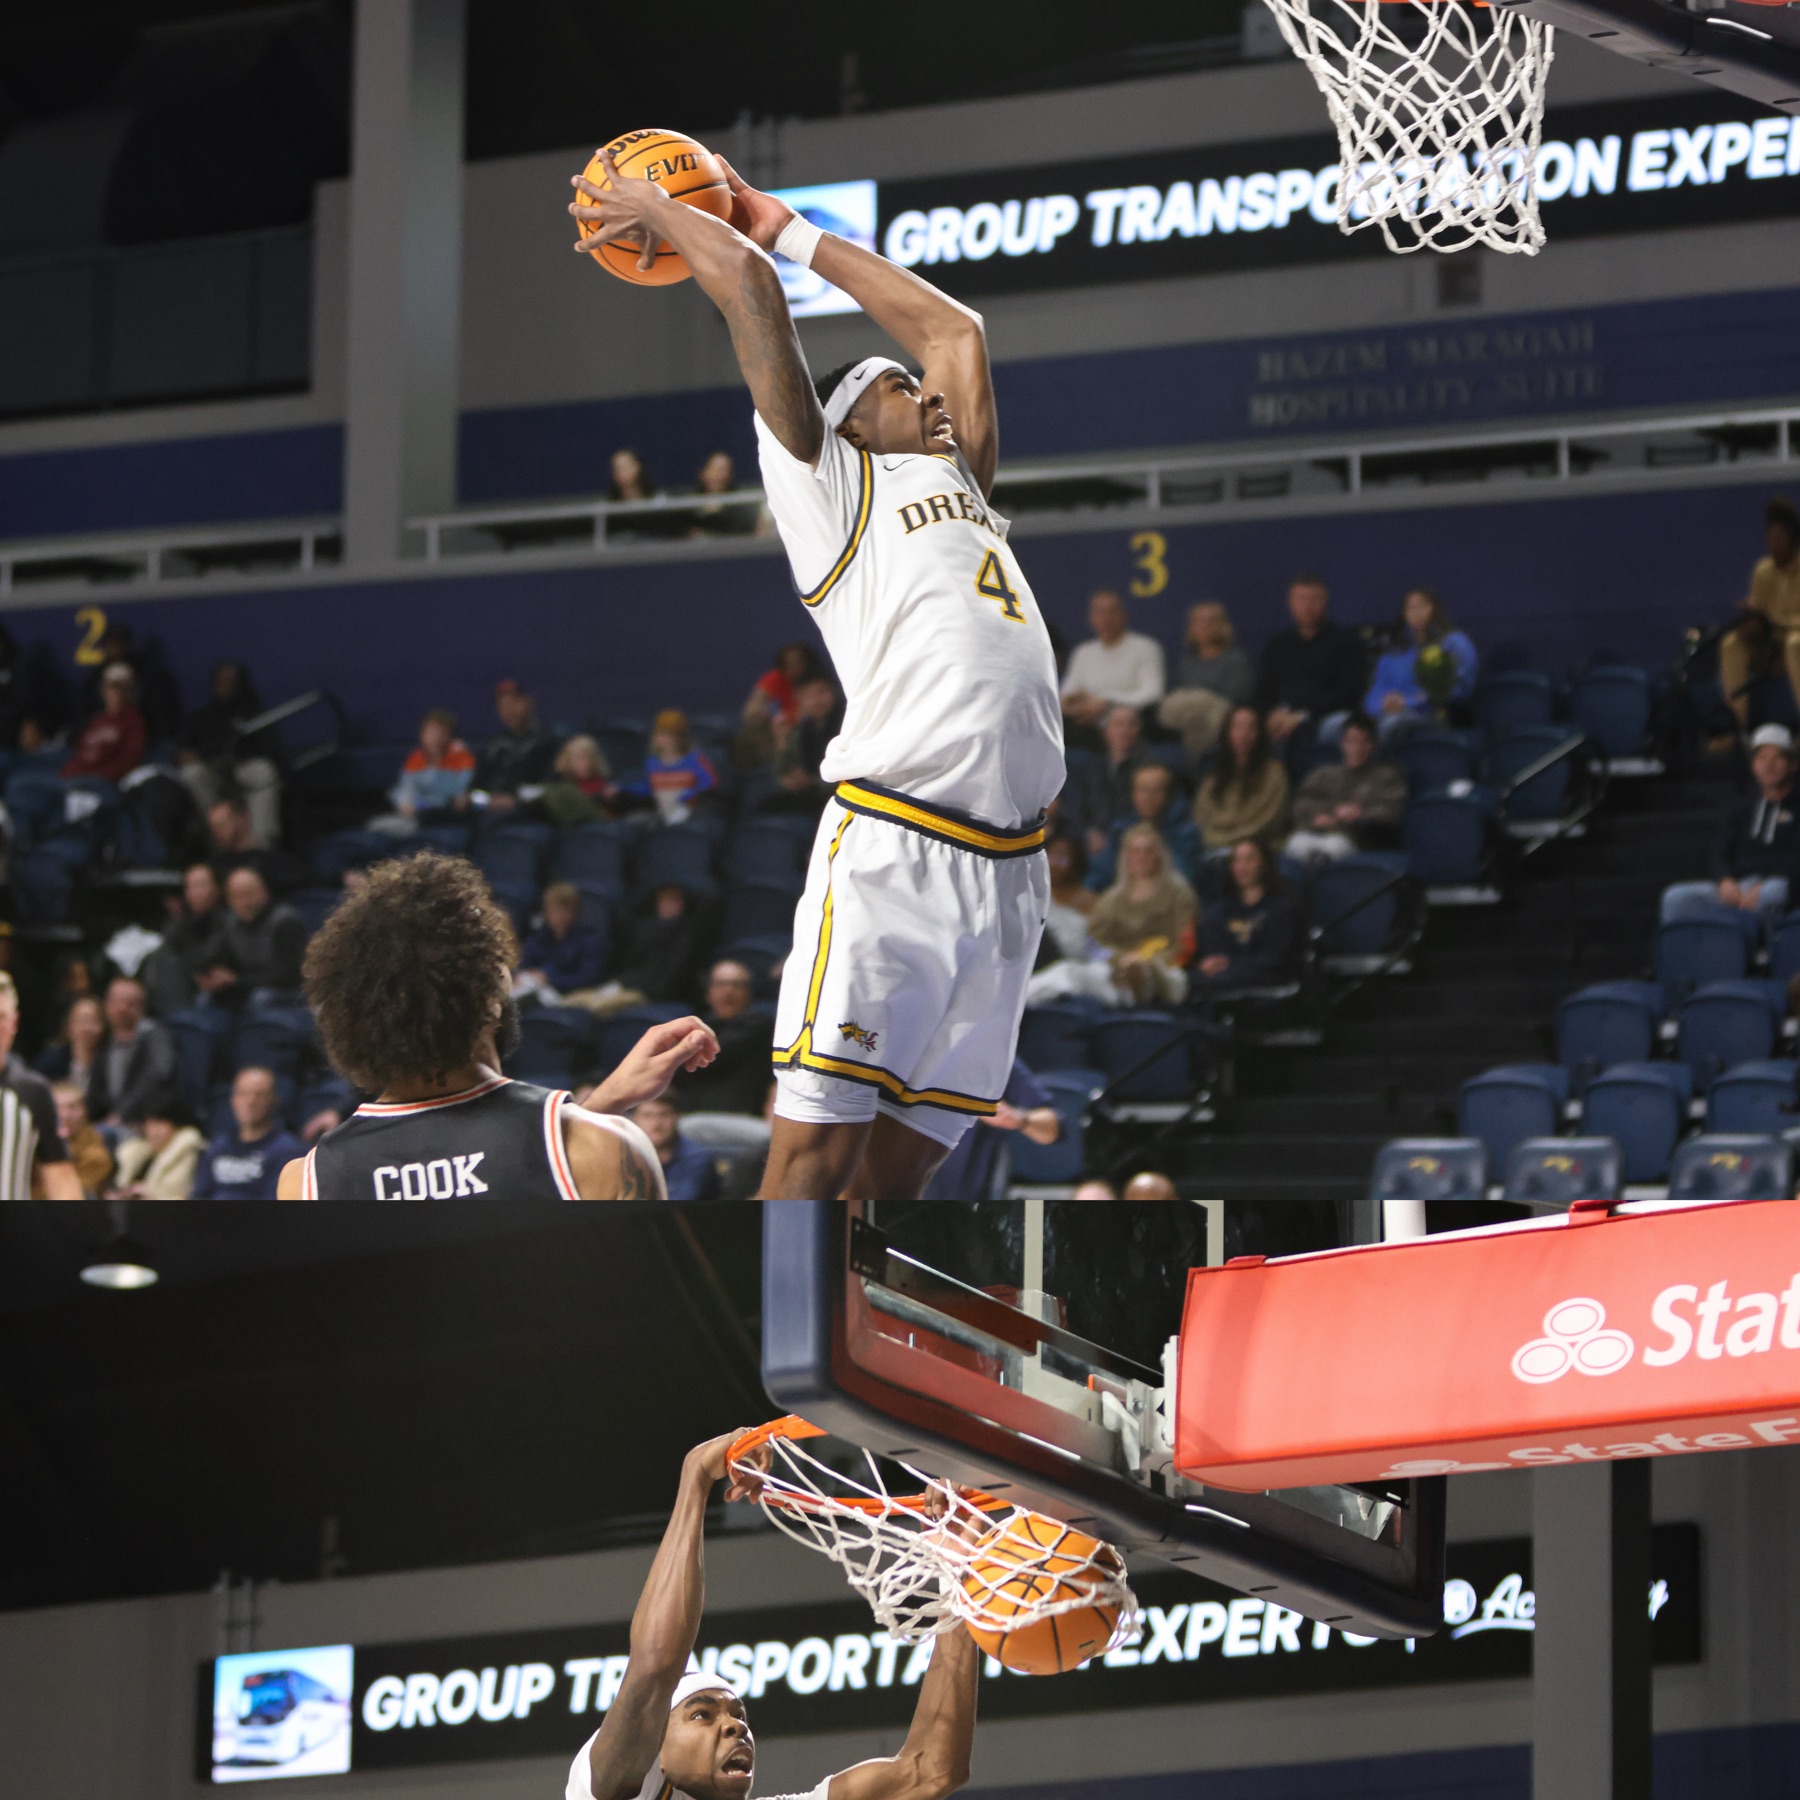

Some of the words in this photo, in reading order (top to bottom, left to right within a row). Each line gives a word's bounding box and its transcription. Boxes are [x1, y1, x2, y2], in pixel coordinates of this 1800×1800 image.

[884, 194, 1080, 268] GROUP
[974, 547, 1027, 625] 4
[1129, 530, 1169, 598] 3
[74, 606, 107, 667] 2
[373, 1151, 489, 1200] COOK
[1507, 1431, 1753, 1465] State
[362, 1662, 556, 1732] GROUP
[1103, 1598, 1380, 1668] EXPER
